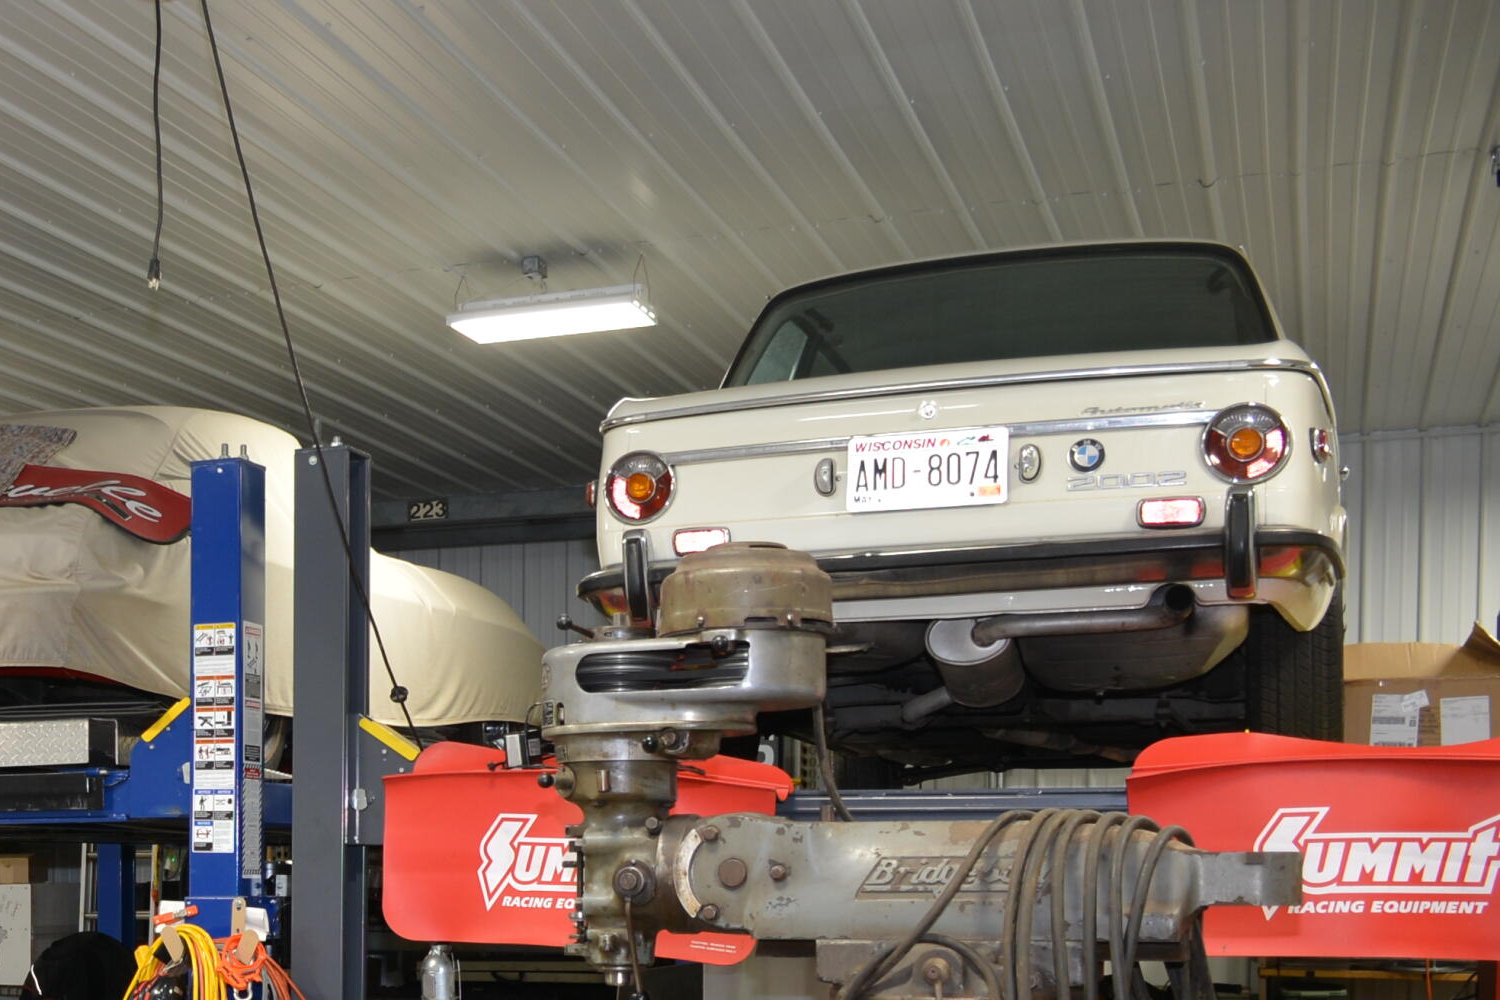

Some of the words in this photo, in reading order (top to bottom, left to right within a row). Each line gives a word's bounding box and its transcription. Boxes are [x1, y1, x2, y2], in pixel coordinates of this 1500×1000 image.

[855, 438, 937, 452] WISCONSIN
[855, 450, 999, 493] AMD-8074
[1067, 471, 1187, 491] 2002
[410, 501, 446, 519] 223
[502, 896, 552, 909] RACING
[1370, 901, 1488, 914] EQUIPMENT
